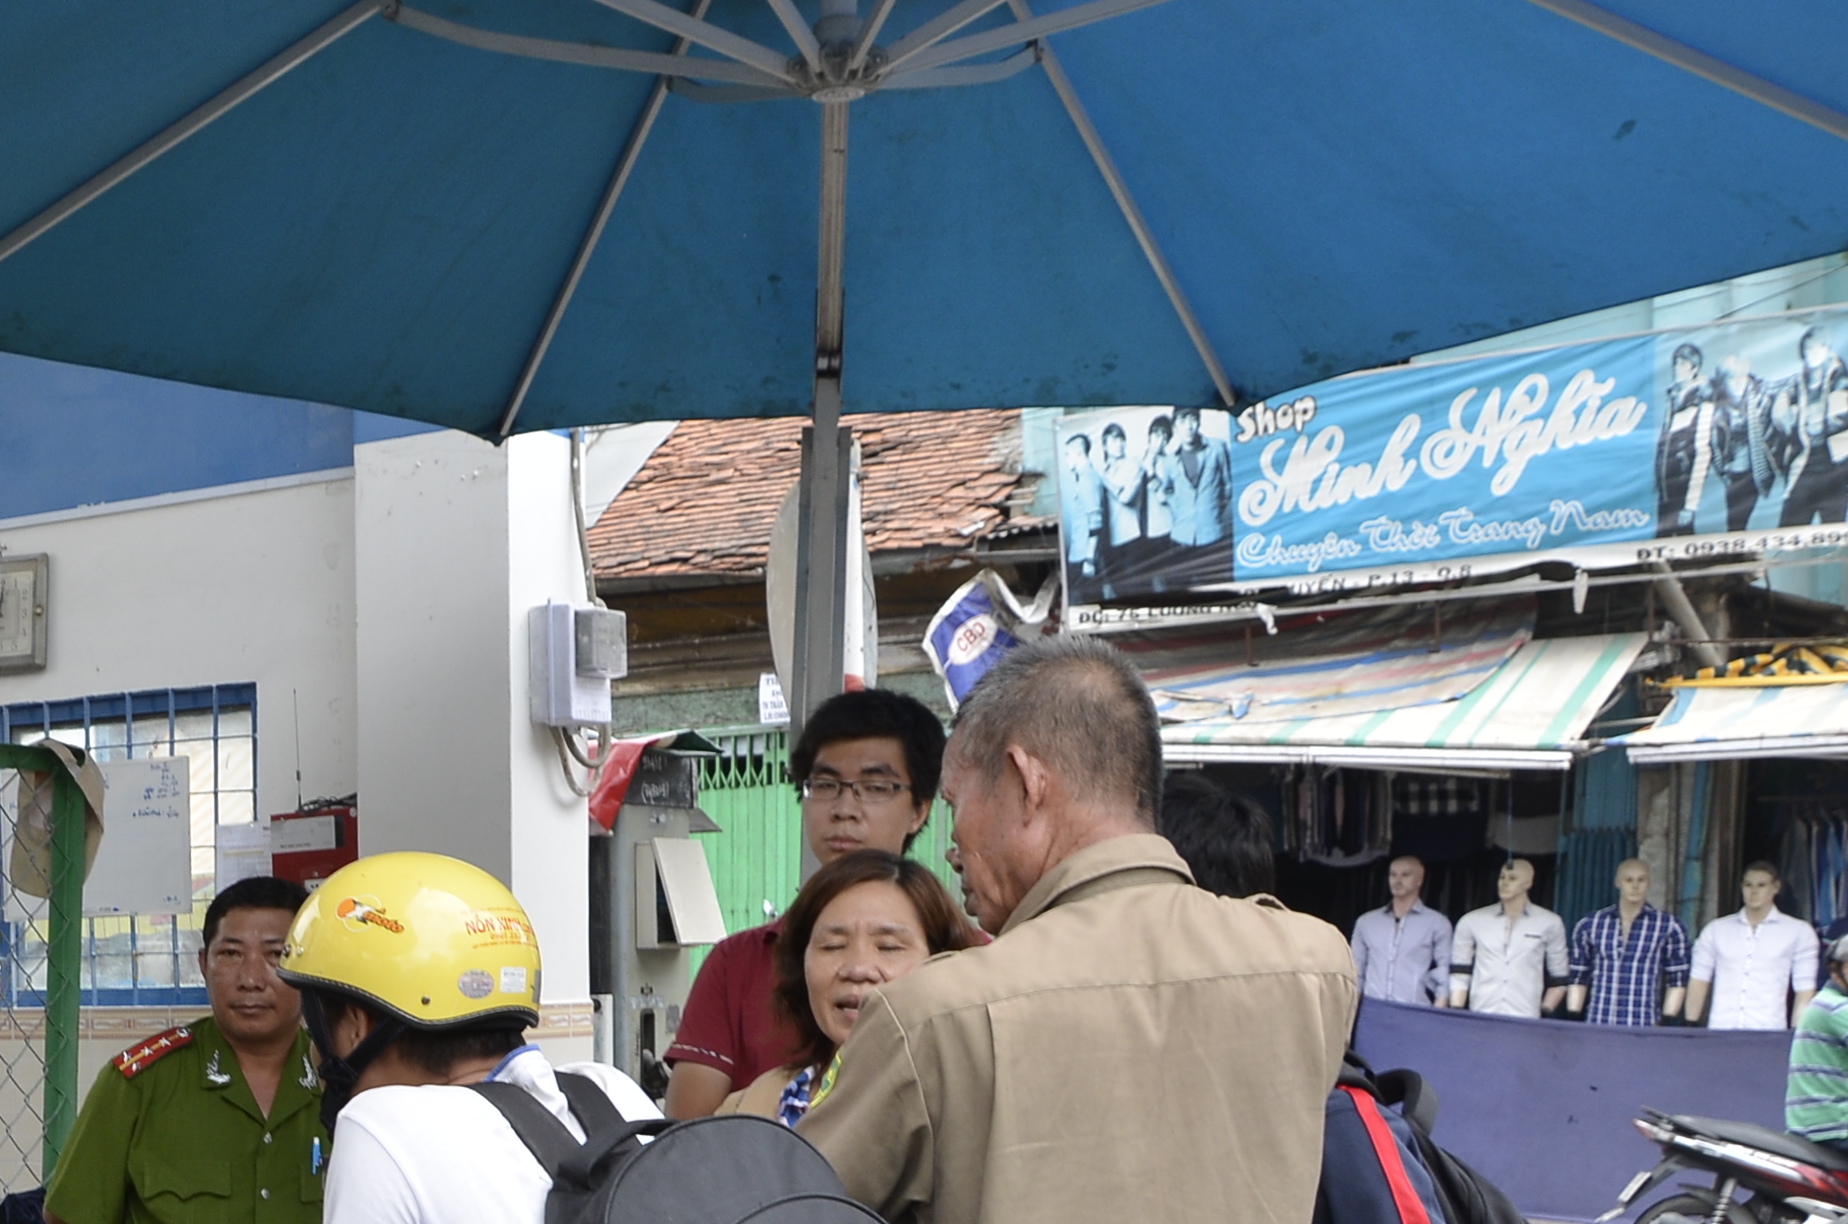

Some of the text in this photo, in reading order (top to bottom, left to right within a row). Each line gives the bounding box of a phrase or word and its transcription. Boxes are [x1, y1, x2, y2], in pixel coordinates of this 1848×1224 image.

[1235, 395, 1317, 443] Shop
[1238, 412, 1418, 527] Minh
[1236, 531, 1362, 573] Chuyên
[1438, 505, 1547, 550] Trang
[1549, 499, 1650, 536] Nam
[955, 621, 987, 653] CBD
